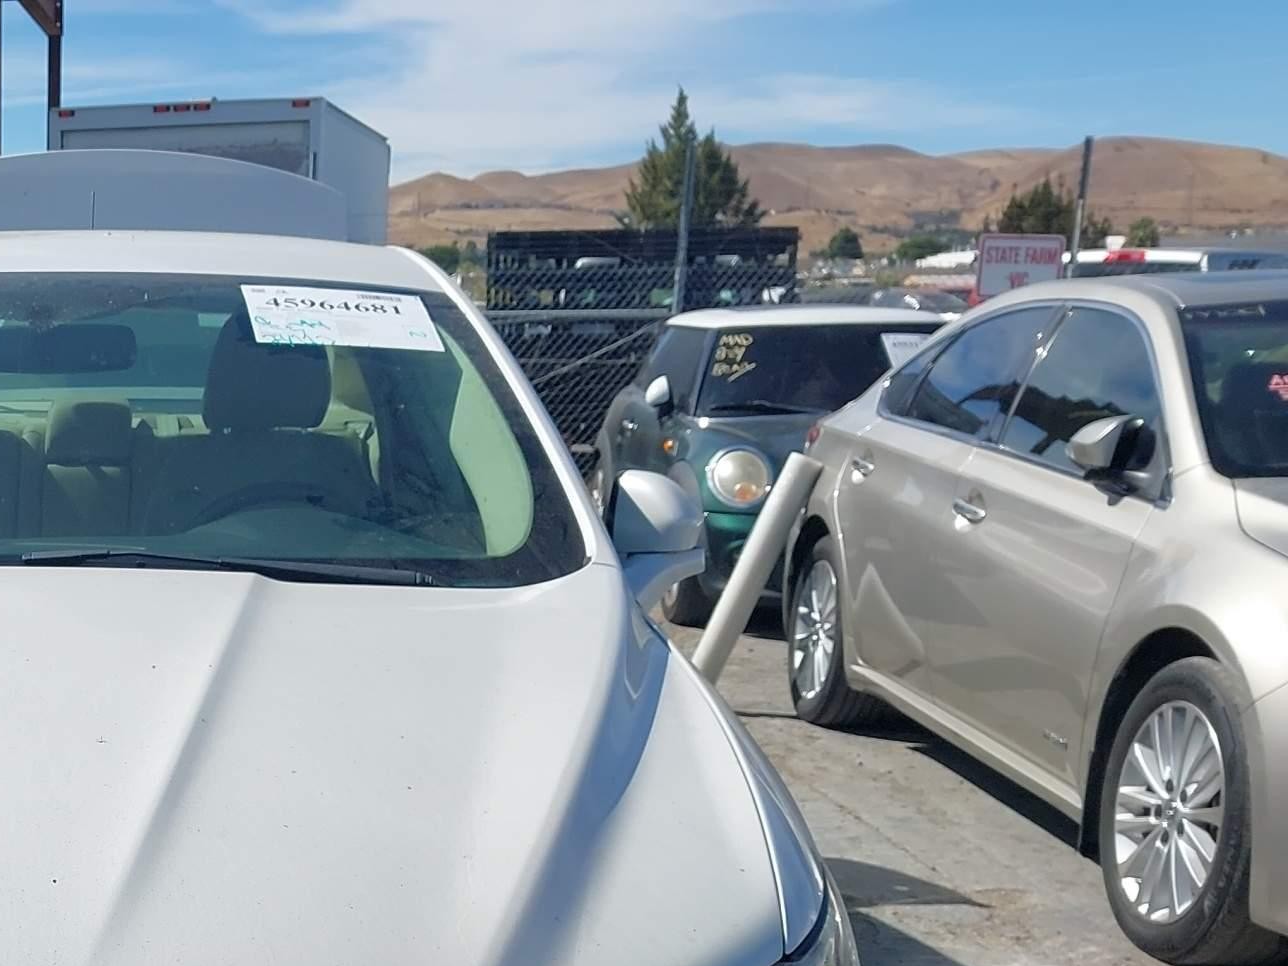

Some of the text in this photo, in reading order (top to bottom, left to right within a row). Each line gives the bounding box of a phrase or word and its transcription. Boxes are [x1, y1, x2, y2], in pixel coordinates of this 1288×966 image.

[985, 246, 1058, 264] STATE FARM
[265, 296, 402, 316] 45964681
